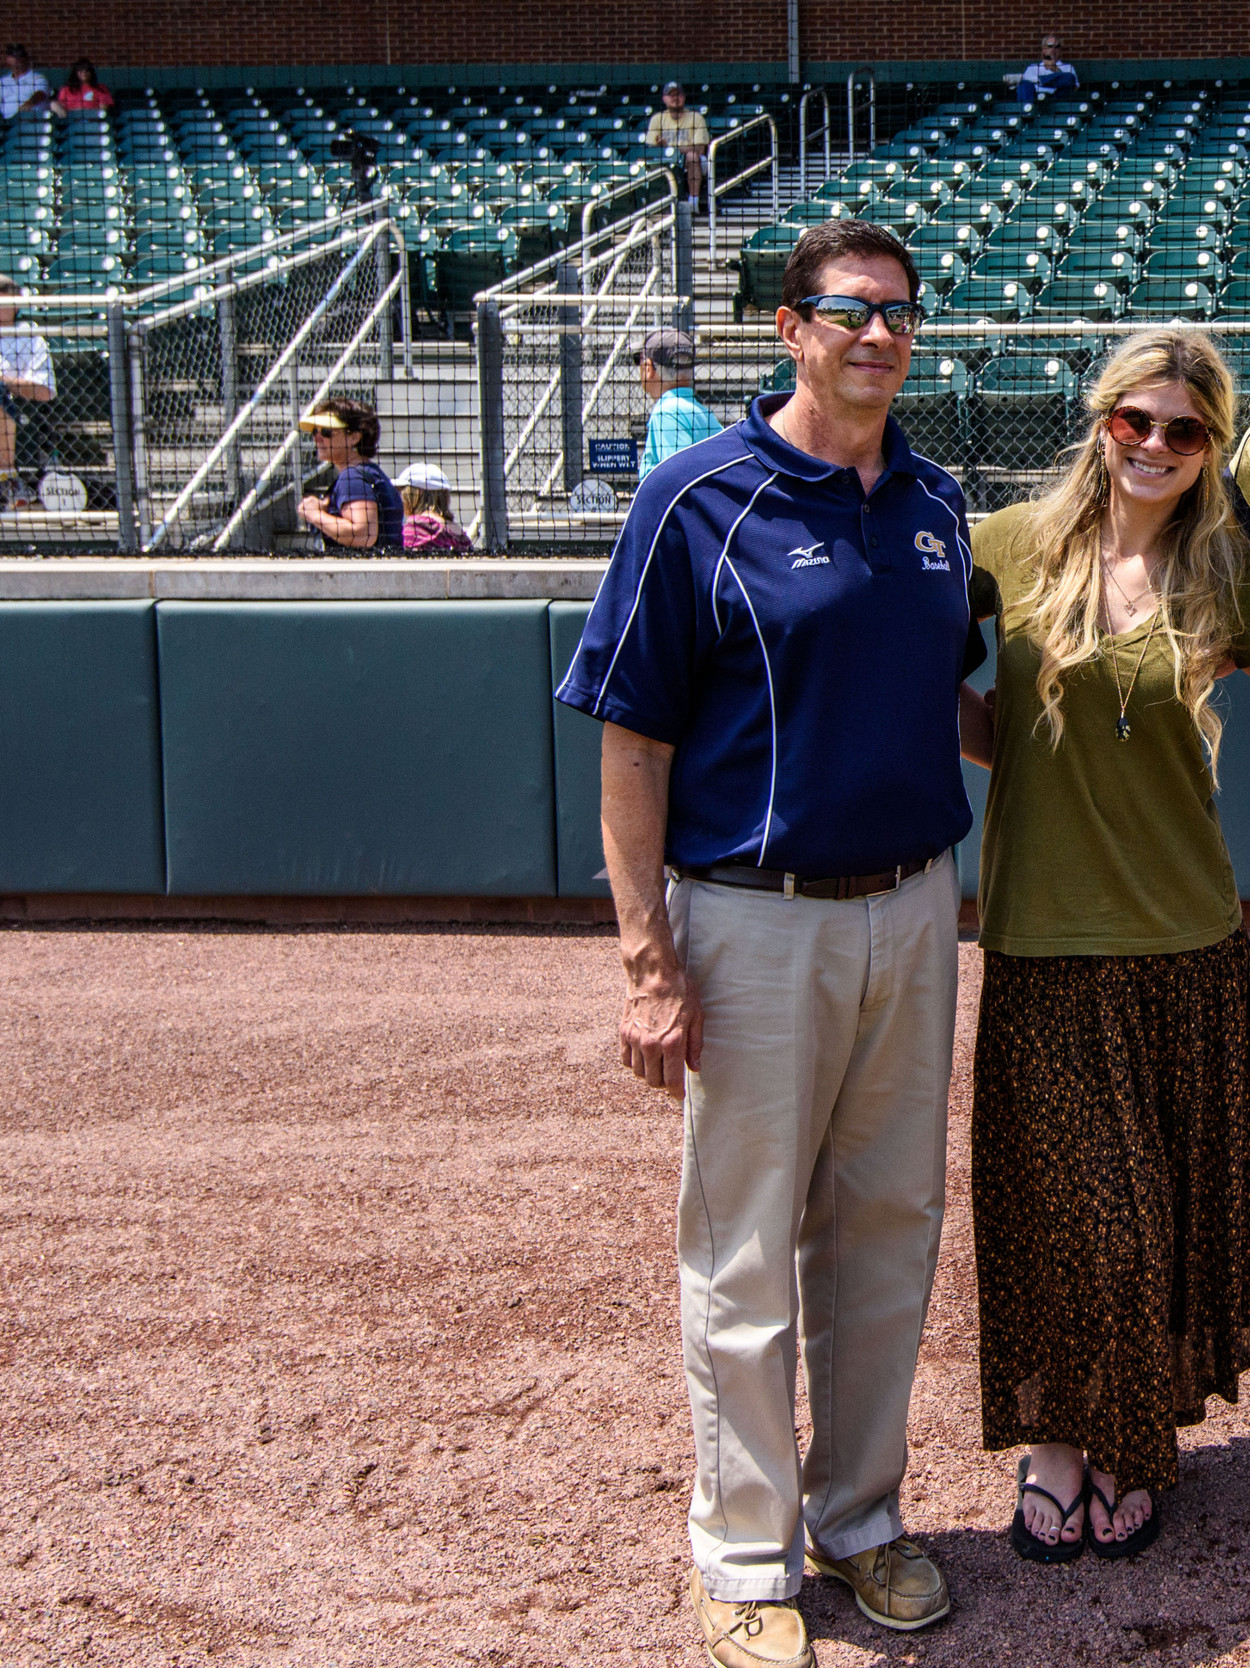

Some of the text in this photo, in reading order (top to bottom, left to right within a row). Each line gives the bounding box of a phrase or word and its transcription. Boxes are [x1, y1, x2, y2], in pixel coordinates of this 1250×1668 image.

[595, 443, 630, 451] CAUTION
[597, 454, 630, 462] SLIPPERY
[46, 488, 81, 496] SECTION
[914, 530, 947, 558] GT
